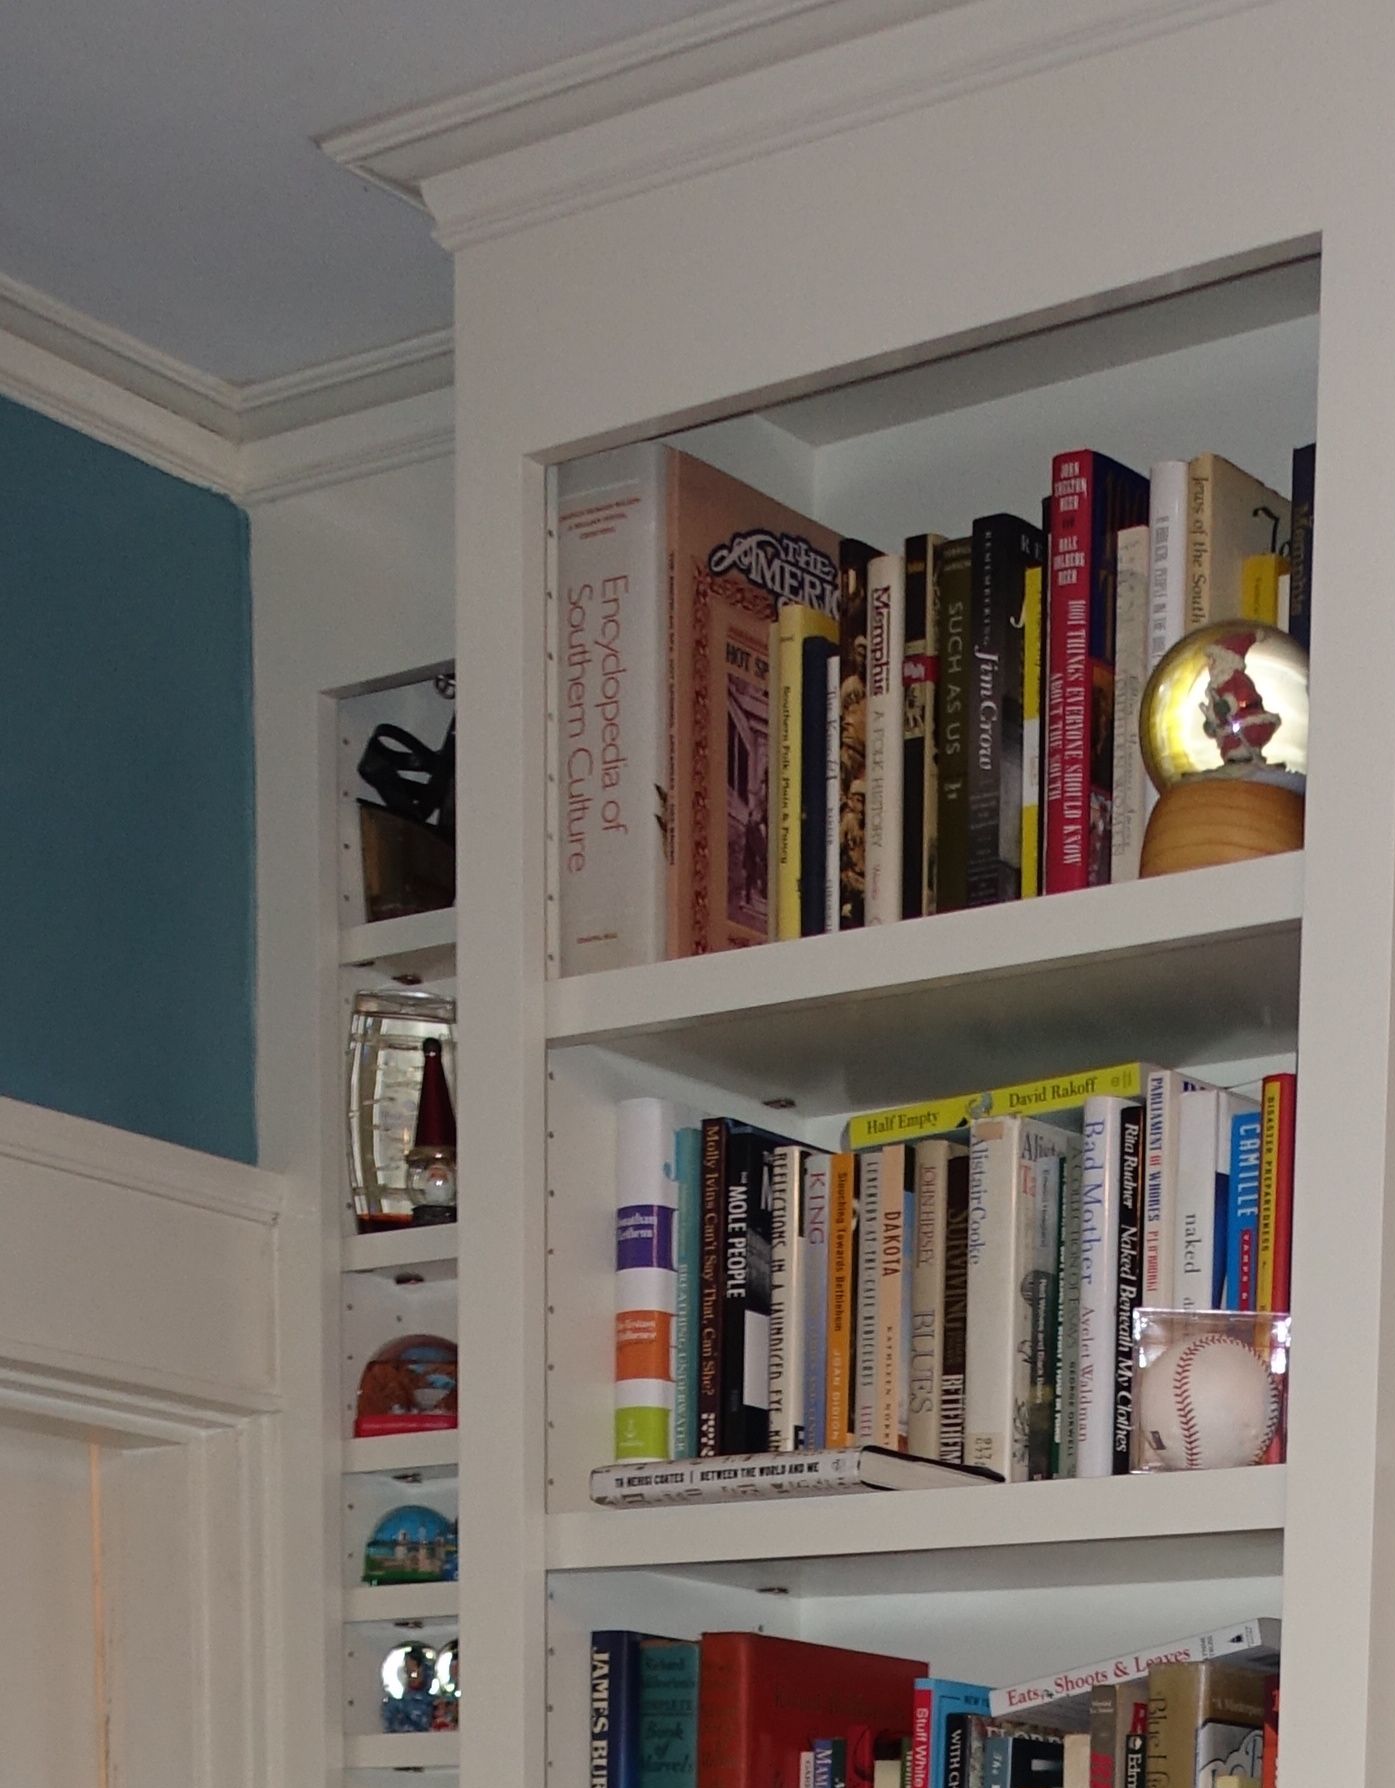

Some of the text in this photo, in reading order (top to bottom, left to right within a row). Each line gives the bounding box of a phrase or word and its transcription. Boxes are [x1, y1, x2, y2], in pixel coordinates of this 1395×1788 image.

[566, 584, 593, 873] Southern Culture
[593, 574, 632, 835] Encyclopedia of
[974, 646, 999, 770] Jim Crow
[867, 1109, 939, 1134] Half Empty
[1009, 1080, 1096, 1108] David Rakoff
[809, 1173, 826, 1245] KING
[969, 1133, 989, 1265] Alistair Cooke
[1083, 1117, 1104, 1284] Bad Mother
[1238, 1123, 1260, 1217] CAMILLE
[726, 1186, 748, 1299] MOLE PEOPLE
[882, 1211, 901, 1277] DAKOTA
[1183, 1214, 1201, 1274] naked
[1115, 1123, 1139, 1451] Rita Rudner Naked Beneath My Clothes
[700, 1462, 819, 1482] BETWEEN THE WORLD AND ME
[591, 1647, 610, 1733] JAMES
[1055, 1668, 1109, 1694] Shoots
[917, 1747, 930, 1781] White
[918, 1708, 932, 1743] Stuff
